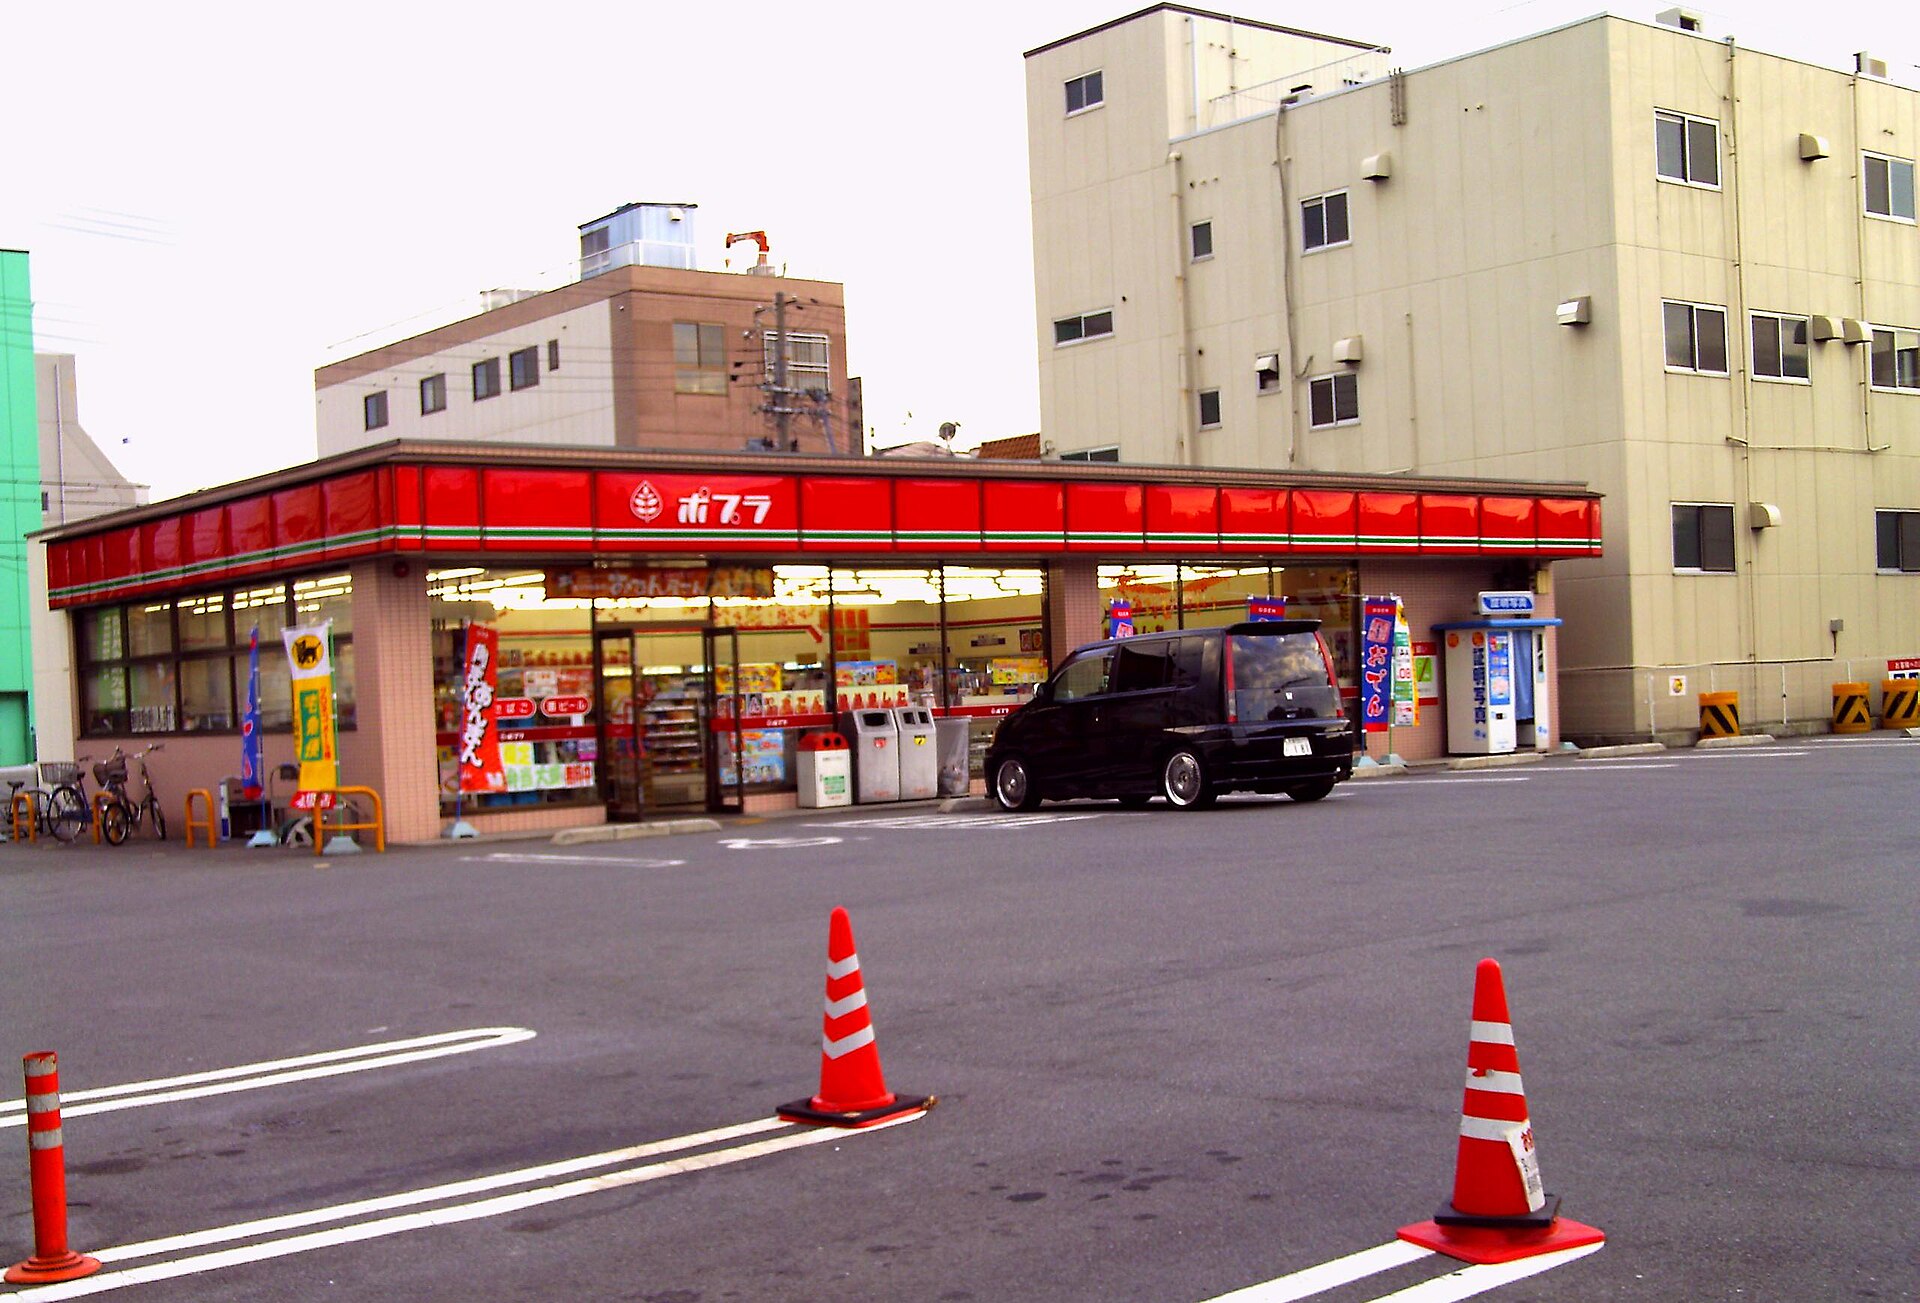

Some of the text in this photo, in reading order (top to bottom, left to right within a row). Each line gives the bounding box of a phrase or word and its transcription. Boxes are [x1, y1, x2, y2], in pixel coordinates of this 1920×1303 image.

[678, 486, 772, 525] ポプラ
[1366, 645, 1388, 717] おでん
